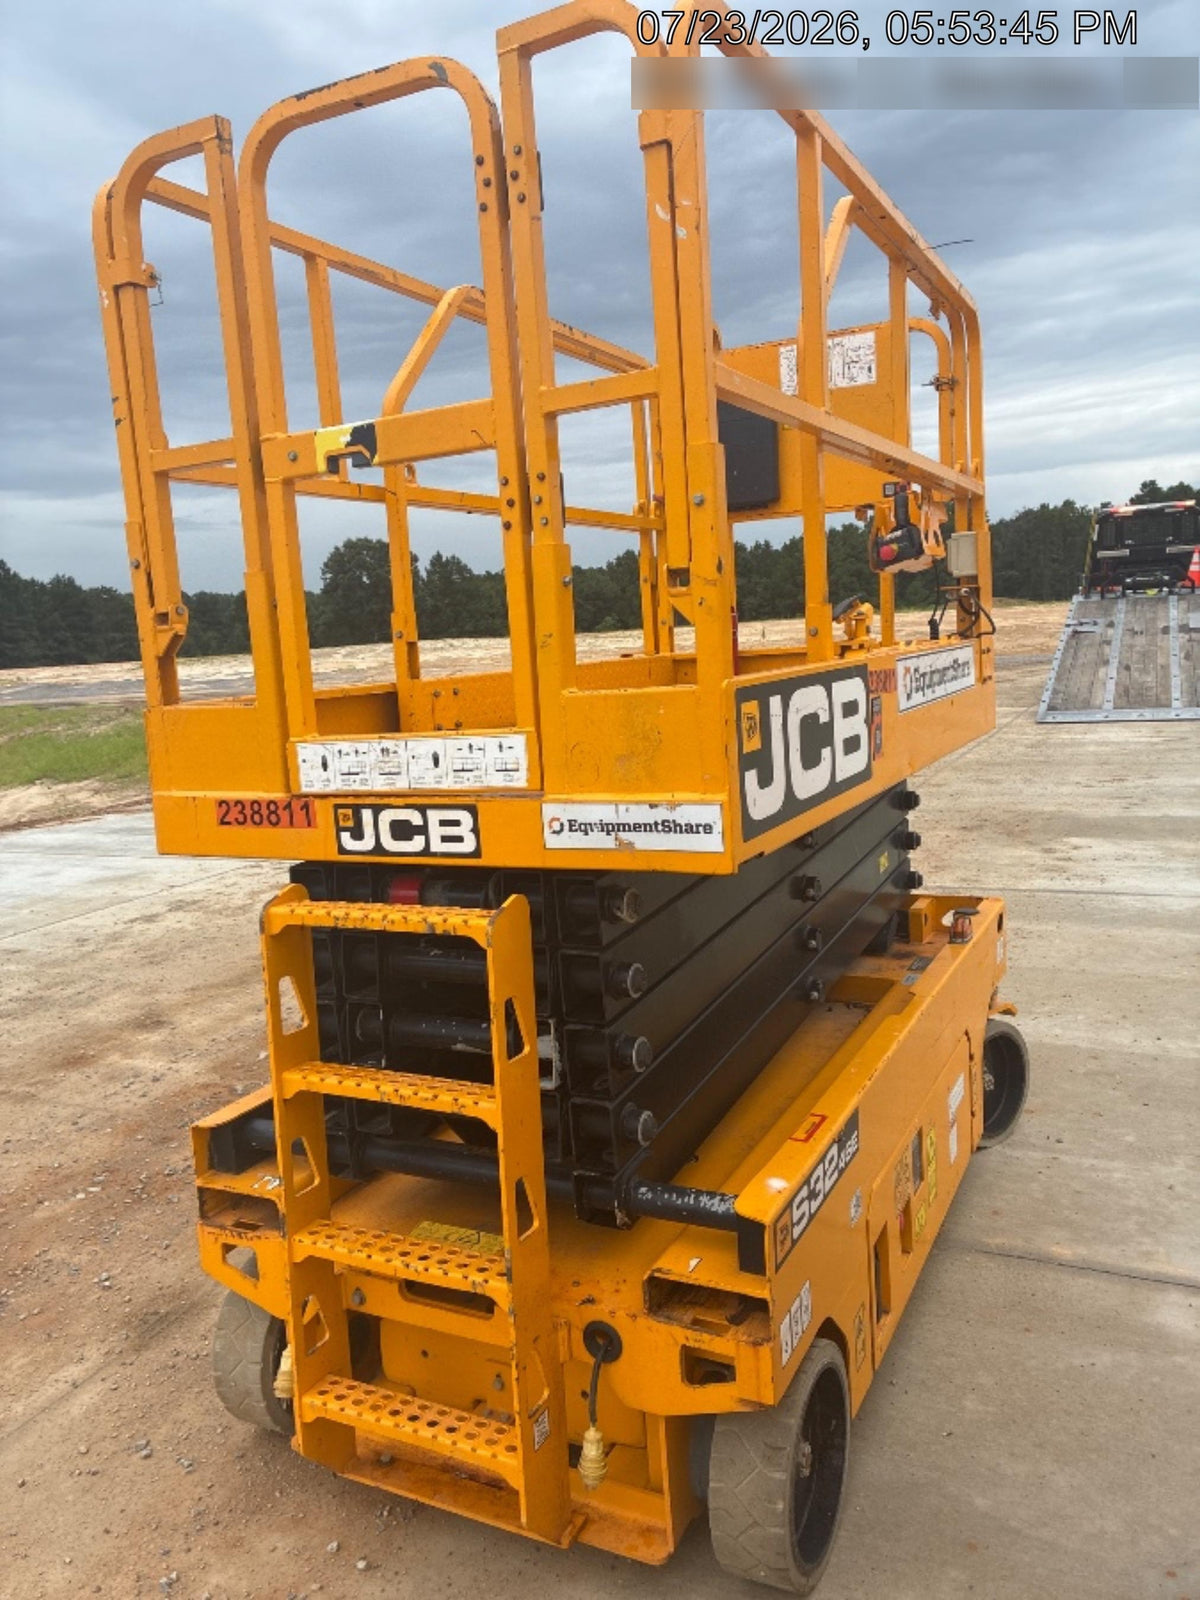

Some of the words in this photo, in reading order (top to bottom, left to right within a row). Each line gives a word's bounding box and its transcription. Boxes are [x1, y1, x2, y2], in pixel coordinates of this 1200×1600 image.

[745, 677, 869, 821] JCB
[217, 800, 312, 827] 238811
[339, 808, 478, 853] JCB
[567, 819, 713, 836] EquipmentShare
